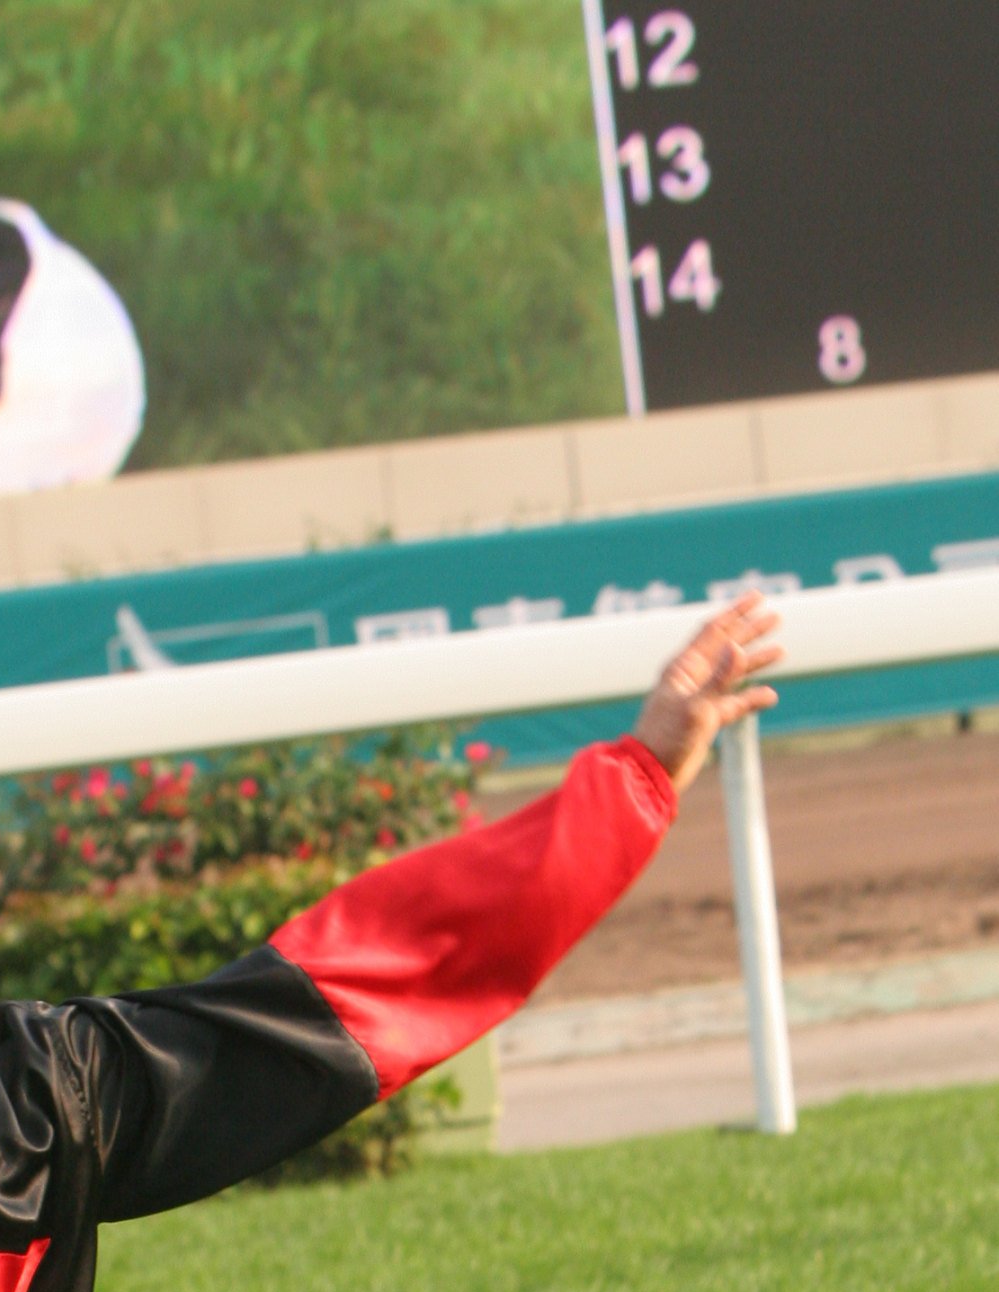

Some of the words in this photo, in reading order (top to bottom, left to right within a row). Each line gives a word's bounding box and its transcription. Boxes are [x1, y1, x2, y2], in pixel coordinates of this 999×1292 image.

[604, 10, 699, 91] 12
[617, 124, 711, 205] 13
[630, 237, 722, 319] 14
[818, 314, 867, 384] 8
